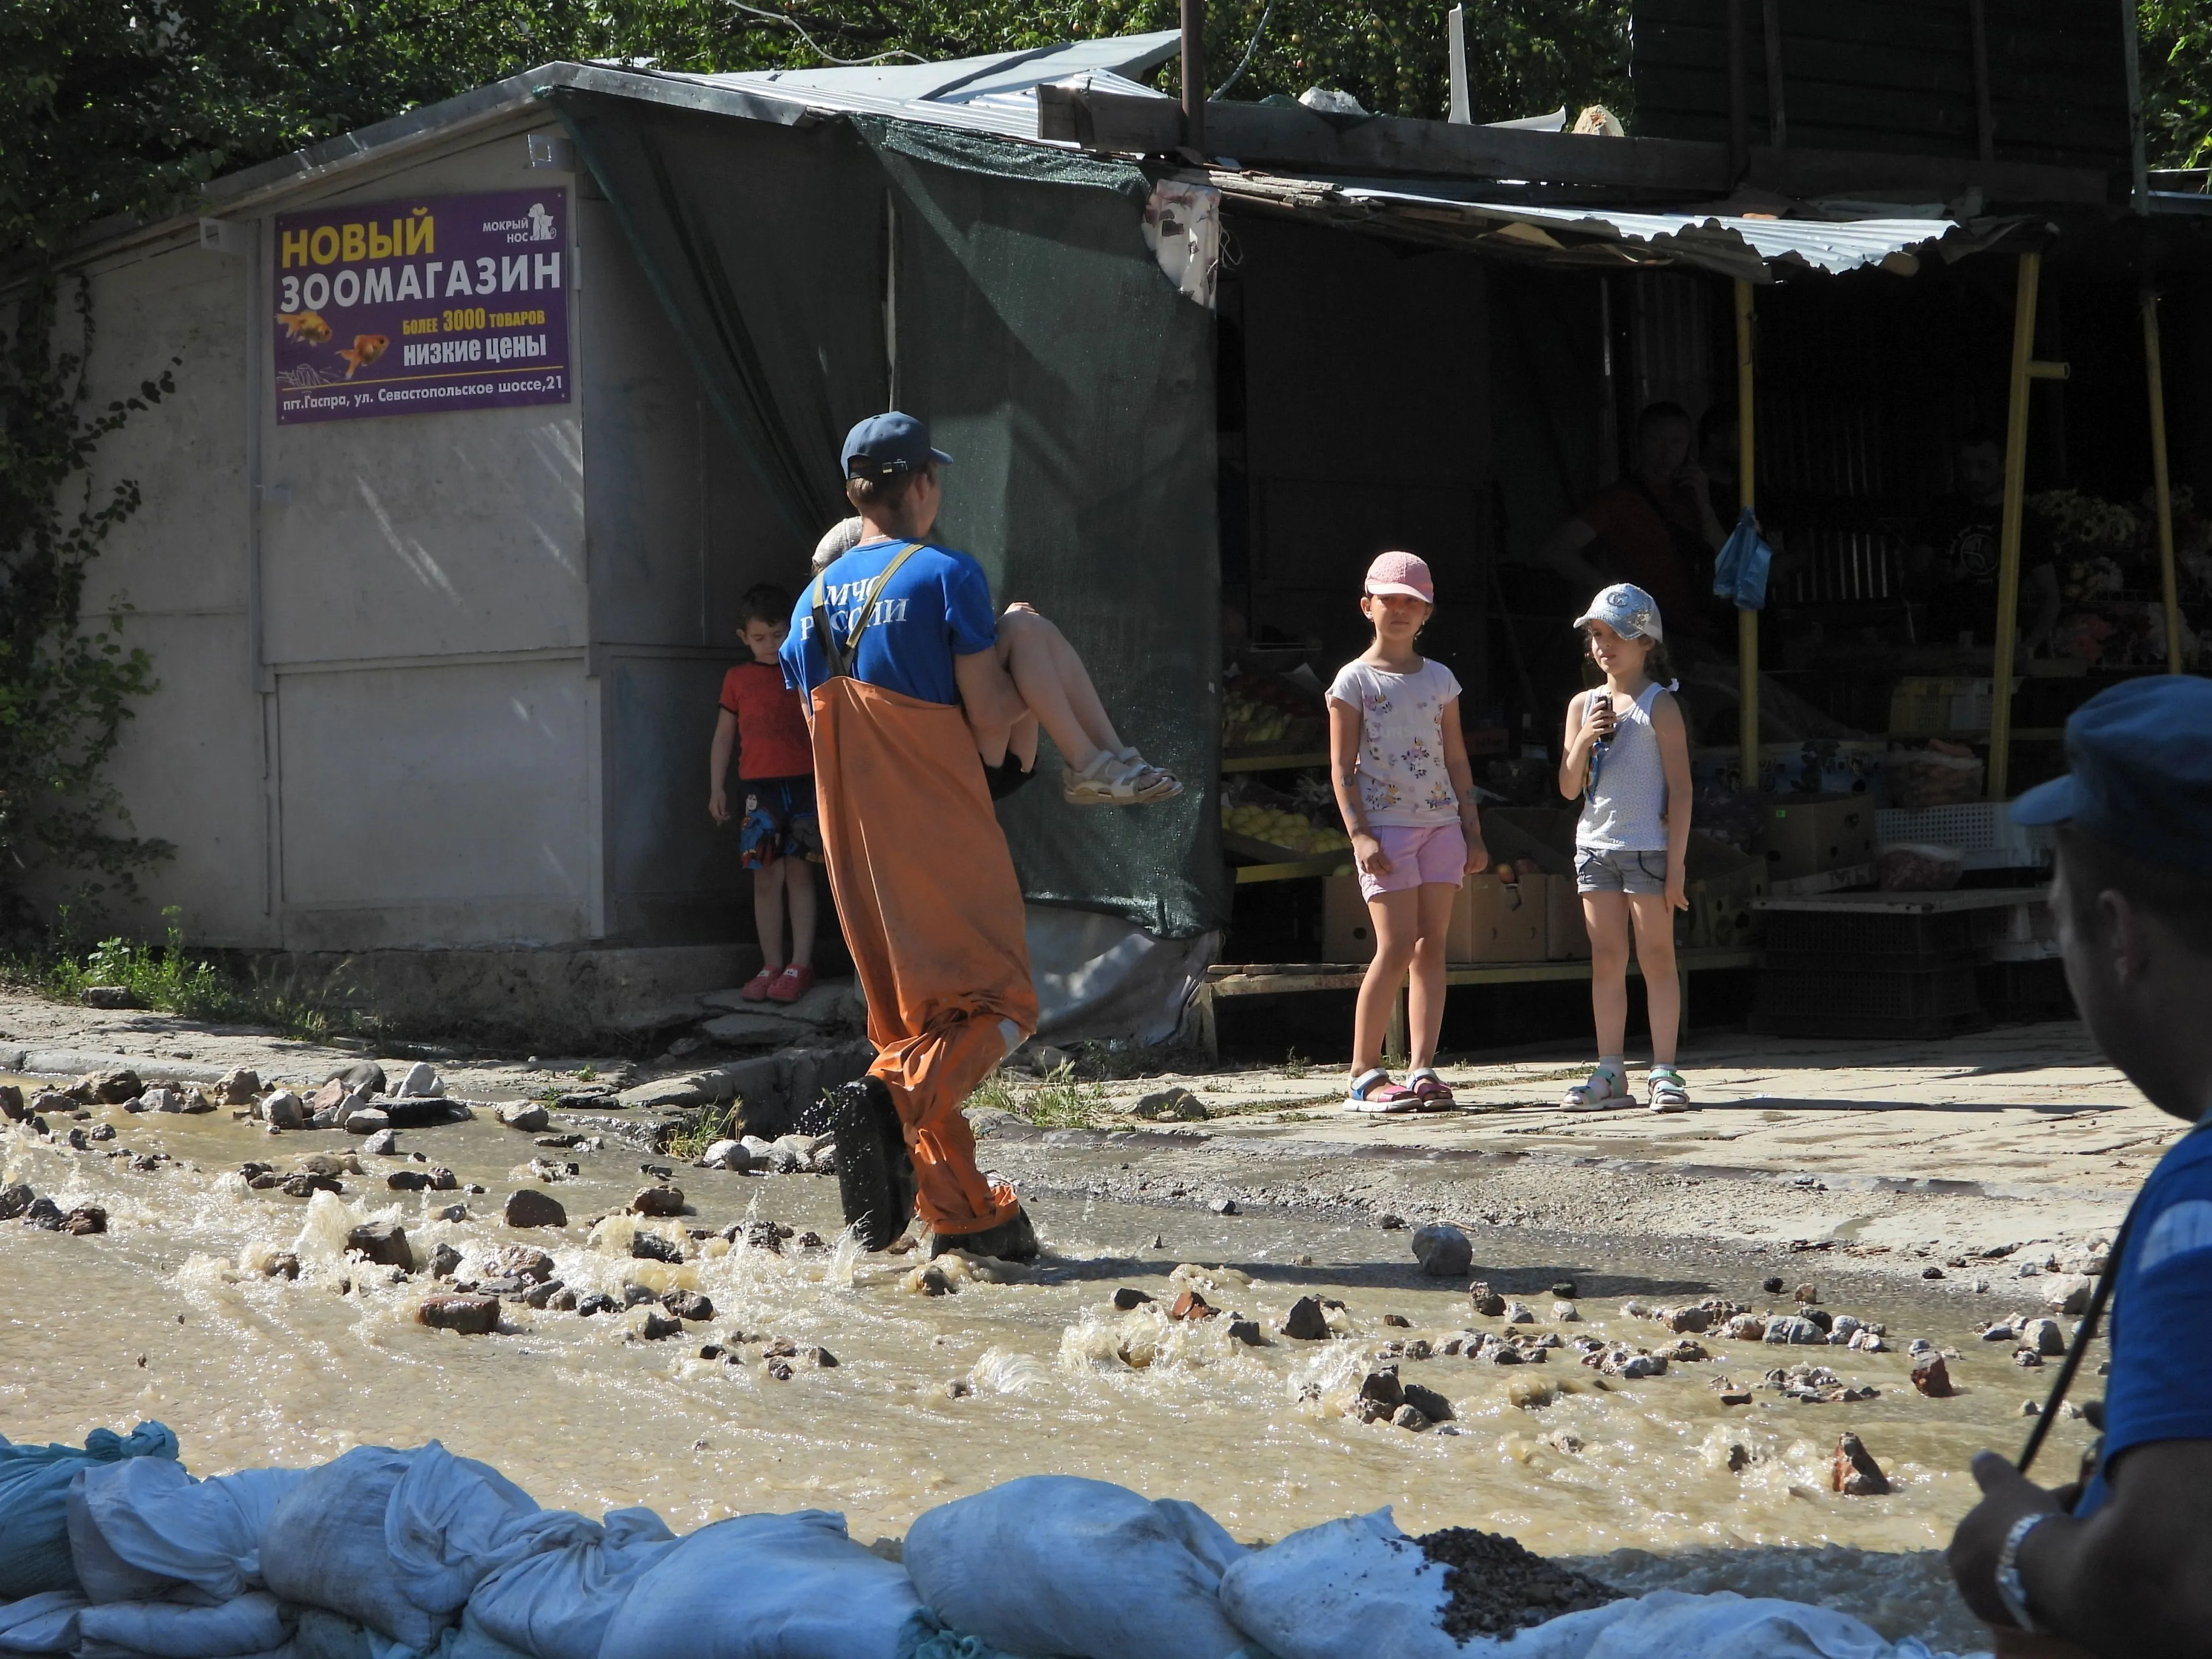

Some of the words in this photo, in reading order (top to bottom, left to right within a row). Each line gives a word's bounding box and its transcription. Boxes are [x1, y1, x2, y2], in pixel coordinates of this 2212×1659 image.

[282, 207, 434, 268] НОВЫЙ
[483, 217, 529, 232] МОКРЫЙ
[507, 233, 528, 244] НОС
[280, 252, 560, 313] ЗООМАГАЗИН
[403, 317, 438, 335] БОЛЕЕ
[442, 308, 486, 331] 3000
[489, 310, 546, 328] ТОВАРОВ
[354, 392, 374, 408] ул.
[378, 384, 493, 402] Севастопольское
[800, 599, 910, 641] РССИИ
